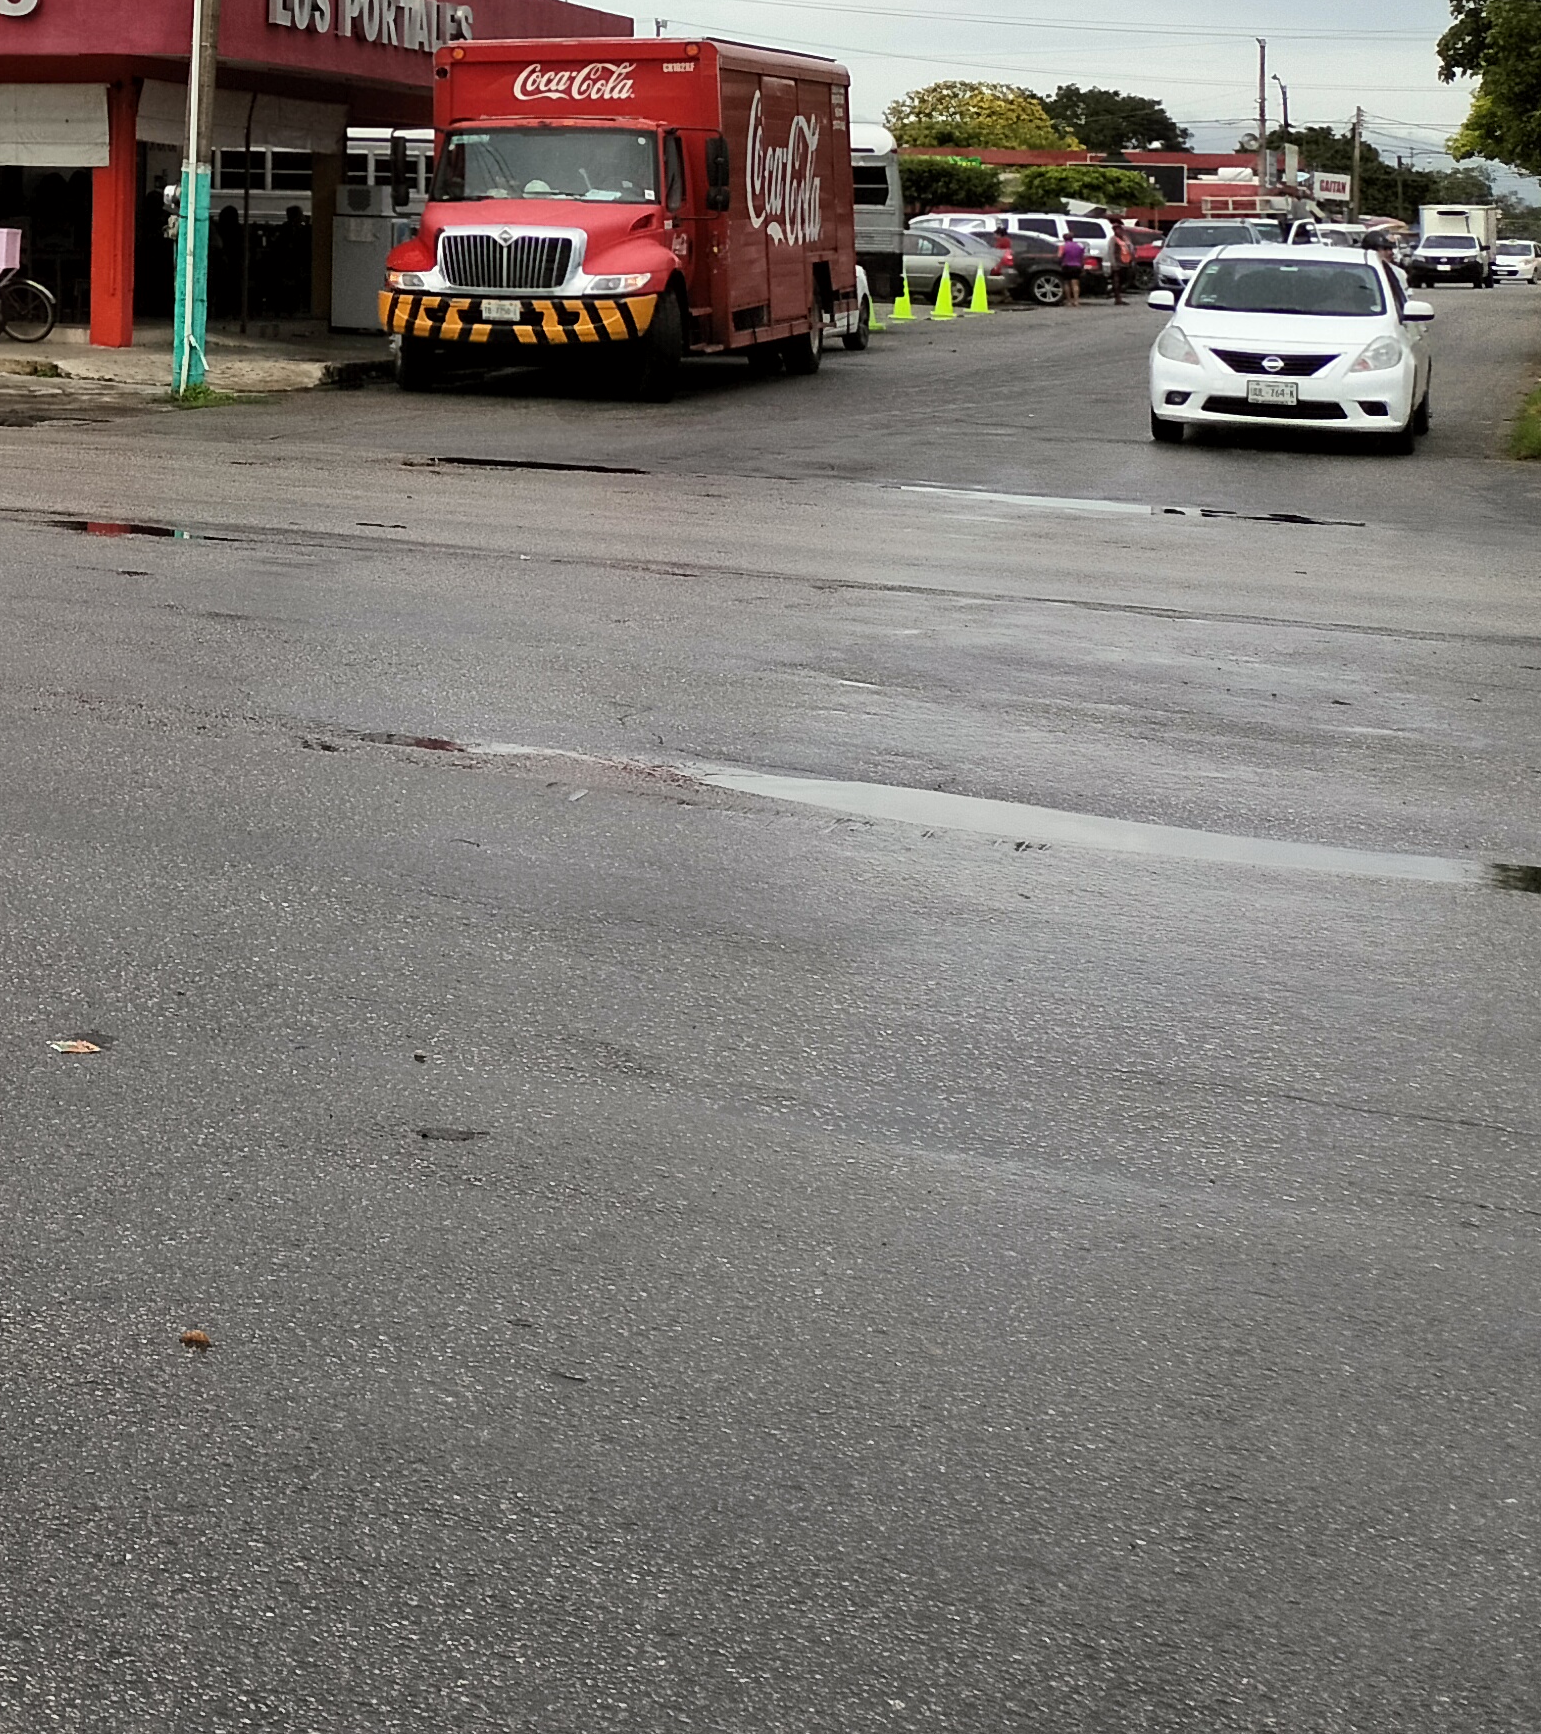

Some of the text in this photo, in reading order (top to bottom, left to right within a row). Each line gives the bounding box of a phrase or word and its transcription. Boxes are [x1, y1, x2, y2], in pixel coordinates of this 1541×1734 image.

[513, 62, 637, 101] Coca-Cola
[746, 89, 822, 247] Coca-Cola
[1320, 179, 1347, 194] GAITAN
